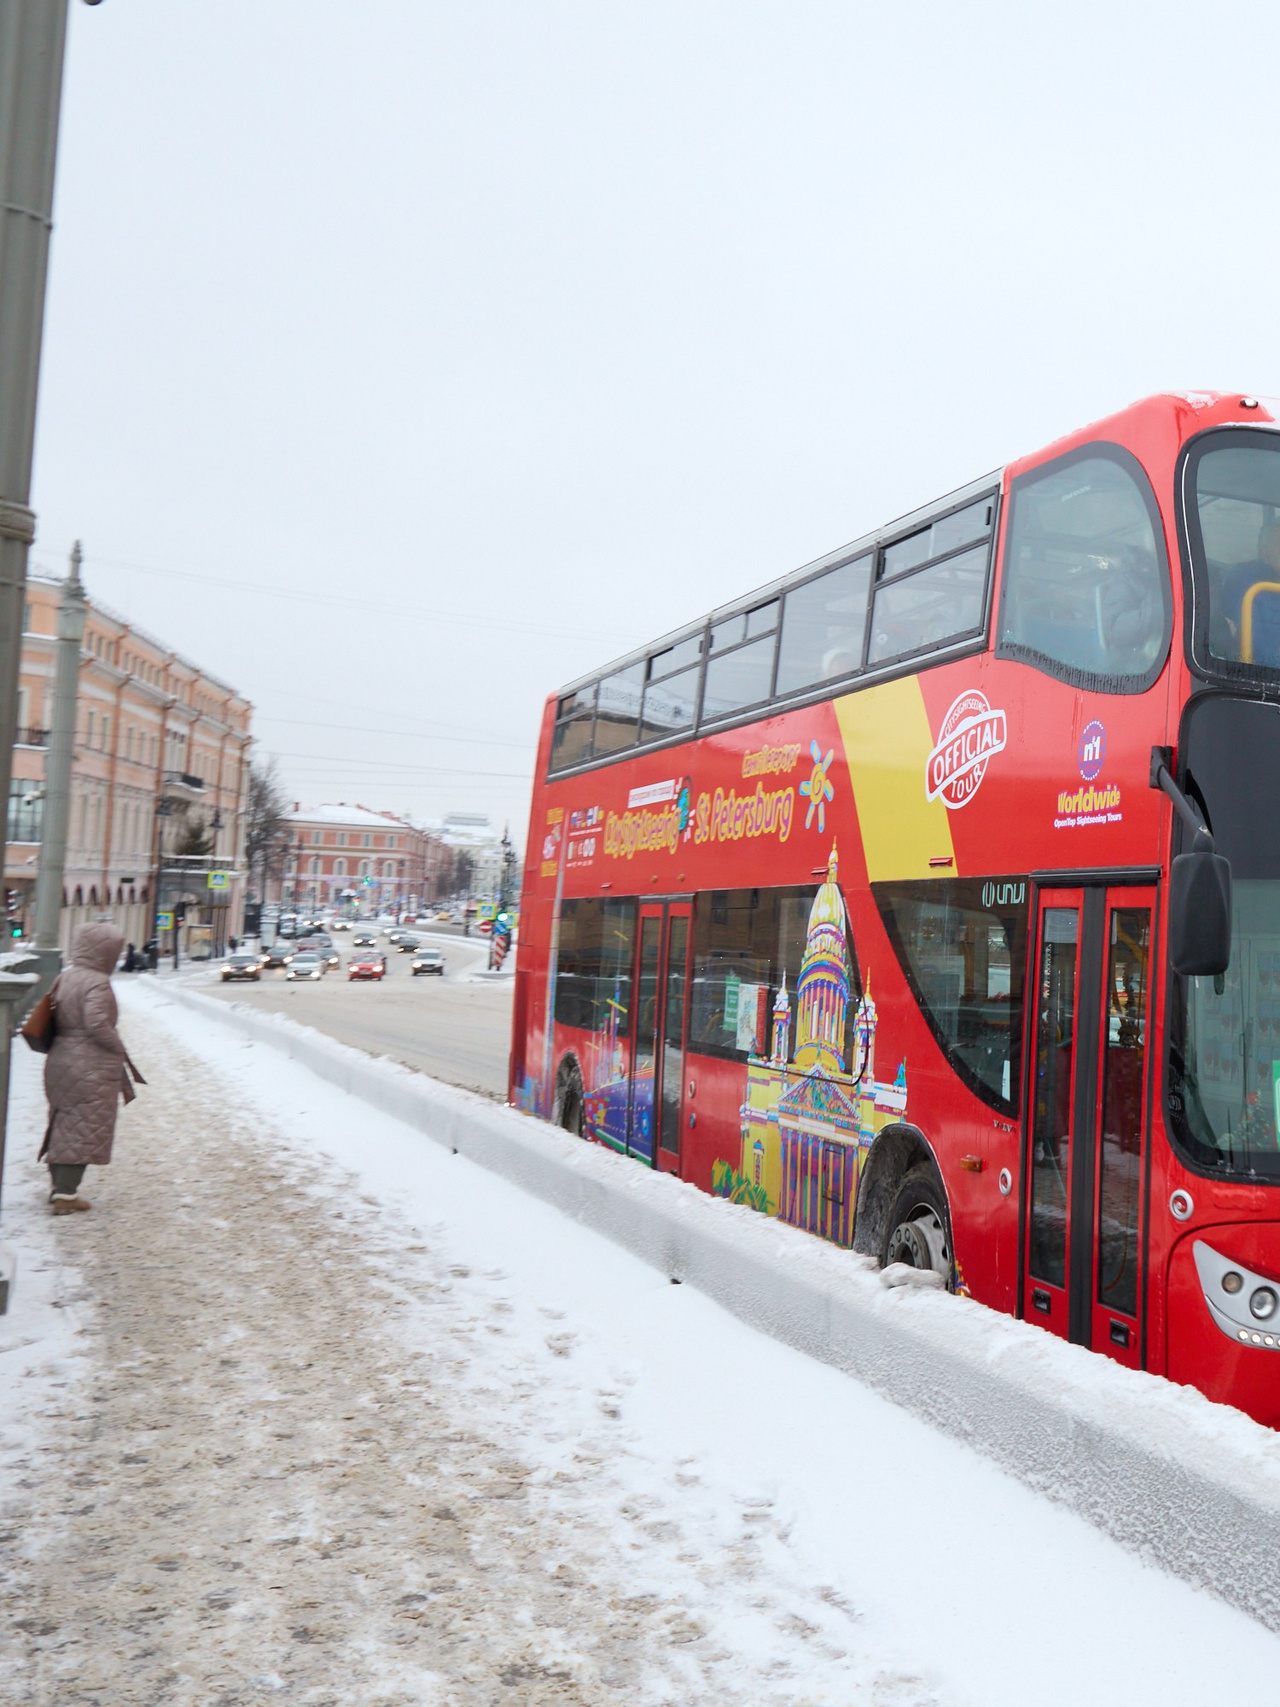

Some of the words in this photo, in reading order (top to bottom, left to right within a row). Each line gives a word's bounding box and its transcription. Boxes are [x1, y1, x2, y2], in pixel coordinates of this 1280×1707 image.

[933, 718, 1001, 786] OFFICIAL
[951, 763, 983, 799] TOUR
[1057, 784, 1121, 814] Worldwide
[710, 781, 794, 842] Petersburg
[1076, 814, 1106, 826] Sightseeing
[1106, 812, 1122, 822] Tours
